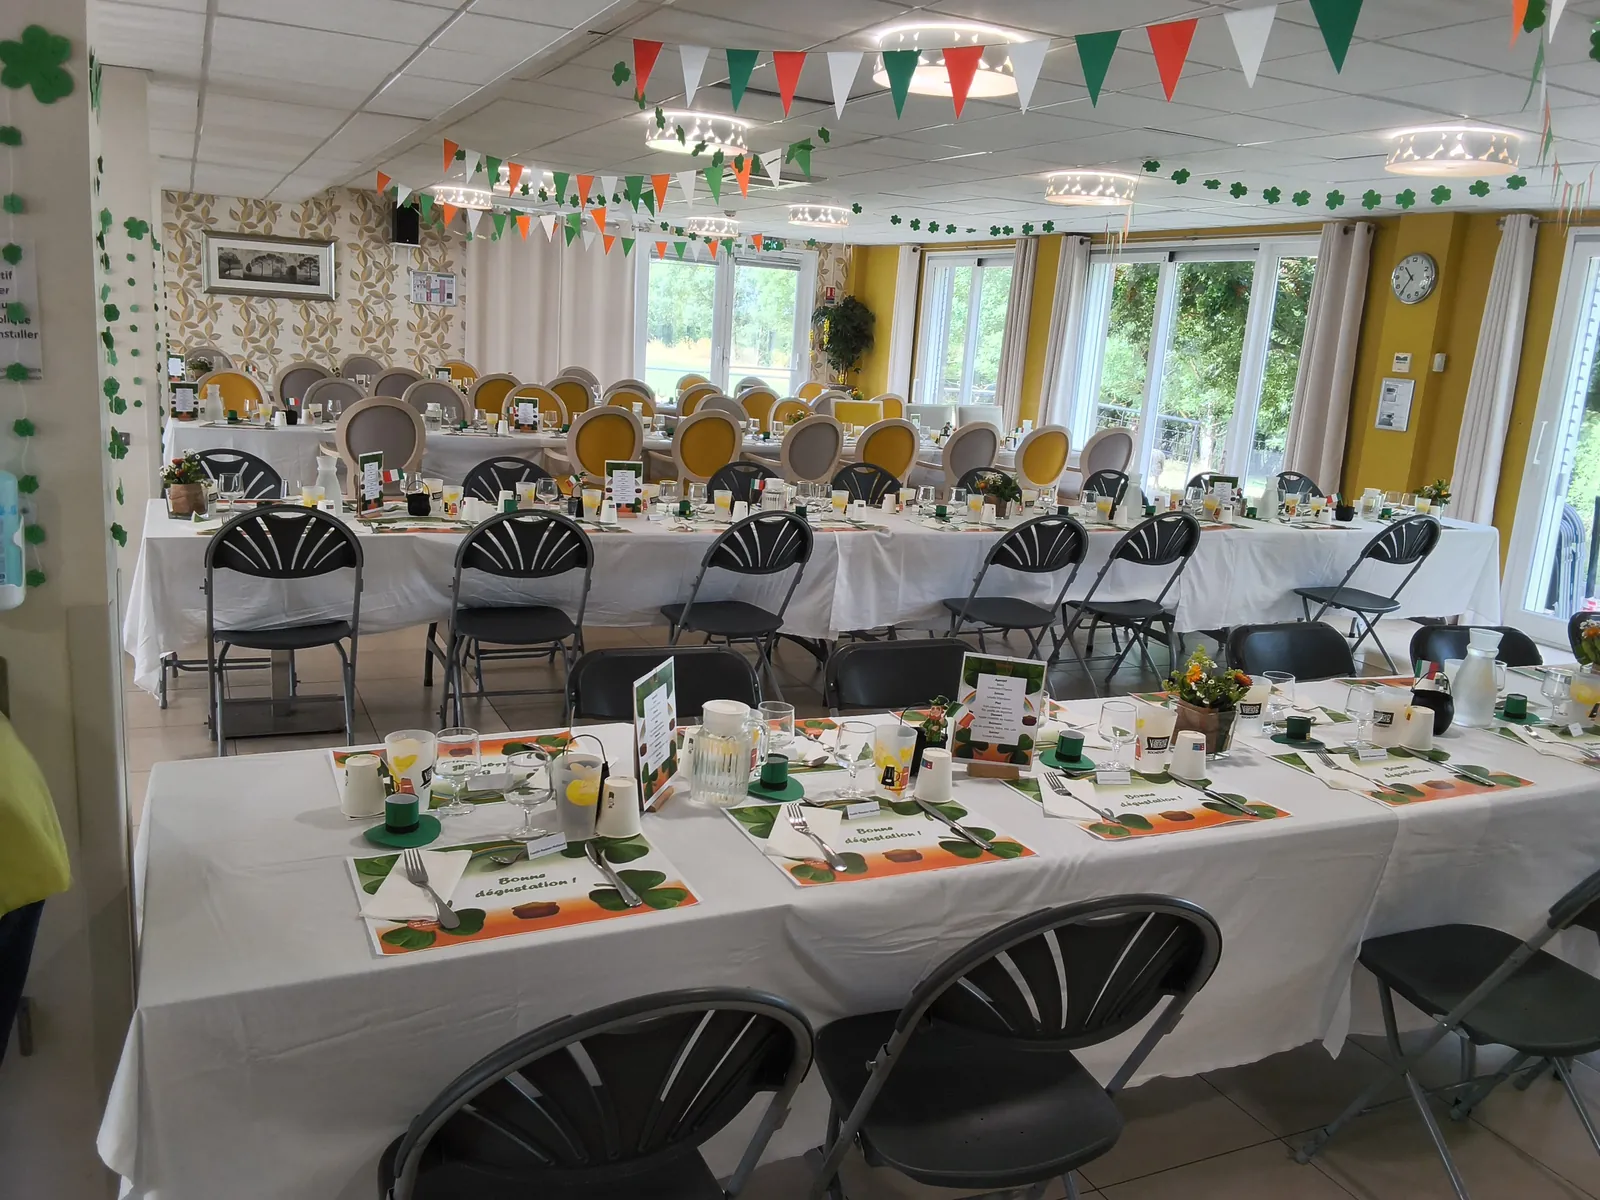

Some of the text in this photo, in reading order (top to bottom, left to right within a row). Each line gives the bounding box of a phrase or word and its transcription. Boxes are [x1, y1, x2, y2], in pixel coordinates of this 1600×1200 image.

[856, 826, 894, 835] Bonne
[844, 832, 916, 844] dégustation
[498, 873, 546, 885] Bonne
[475, 880, 568, 898] dégustation
